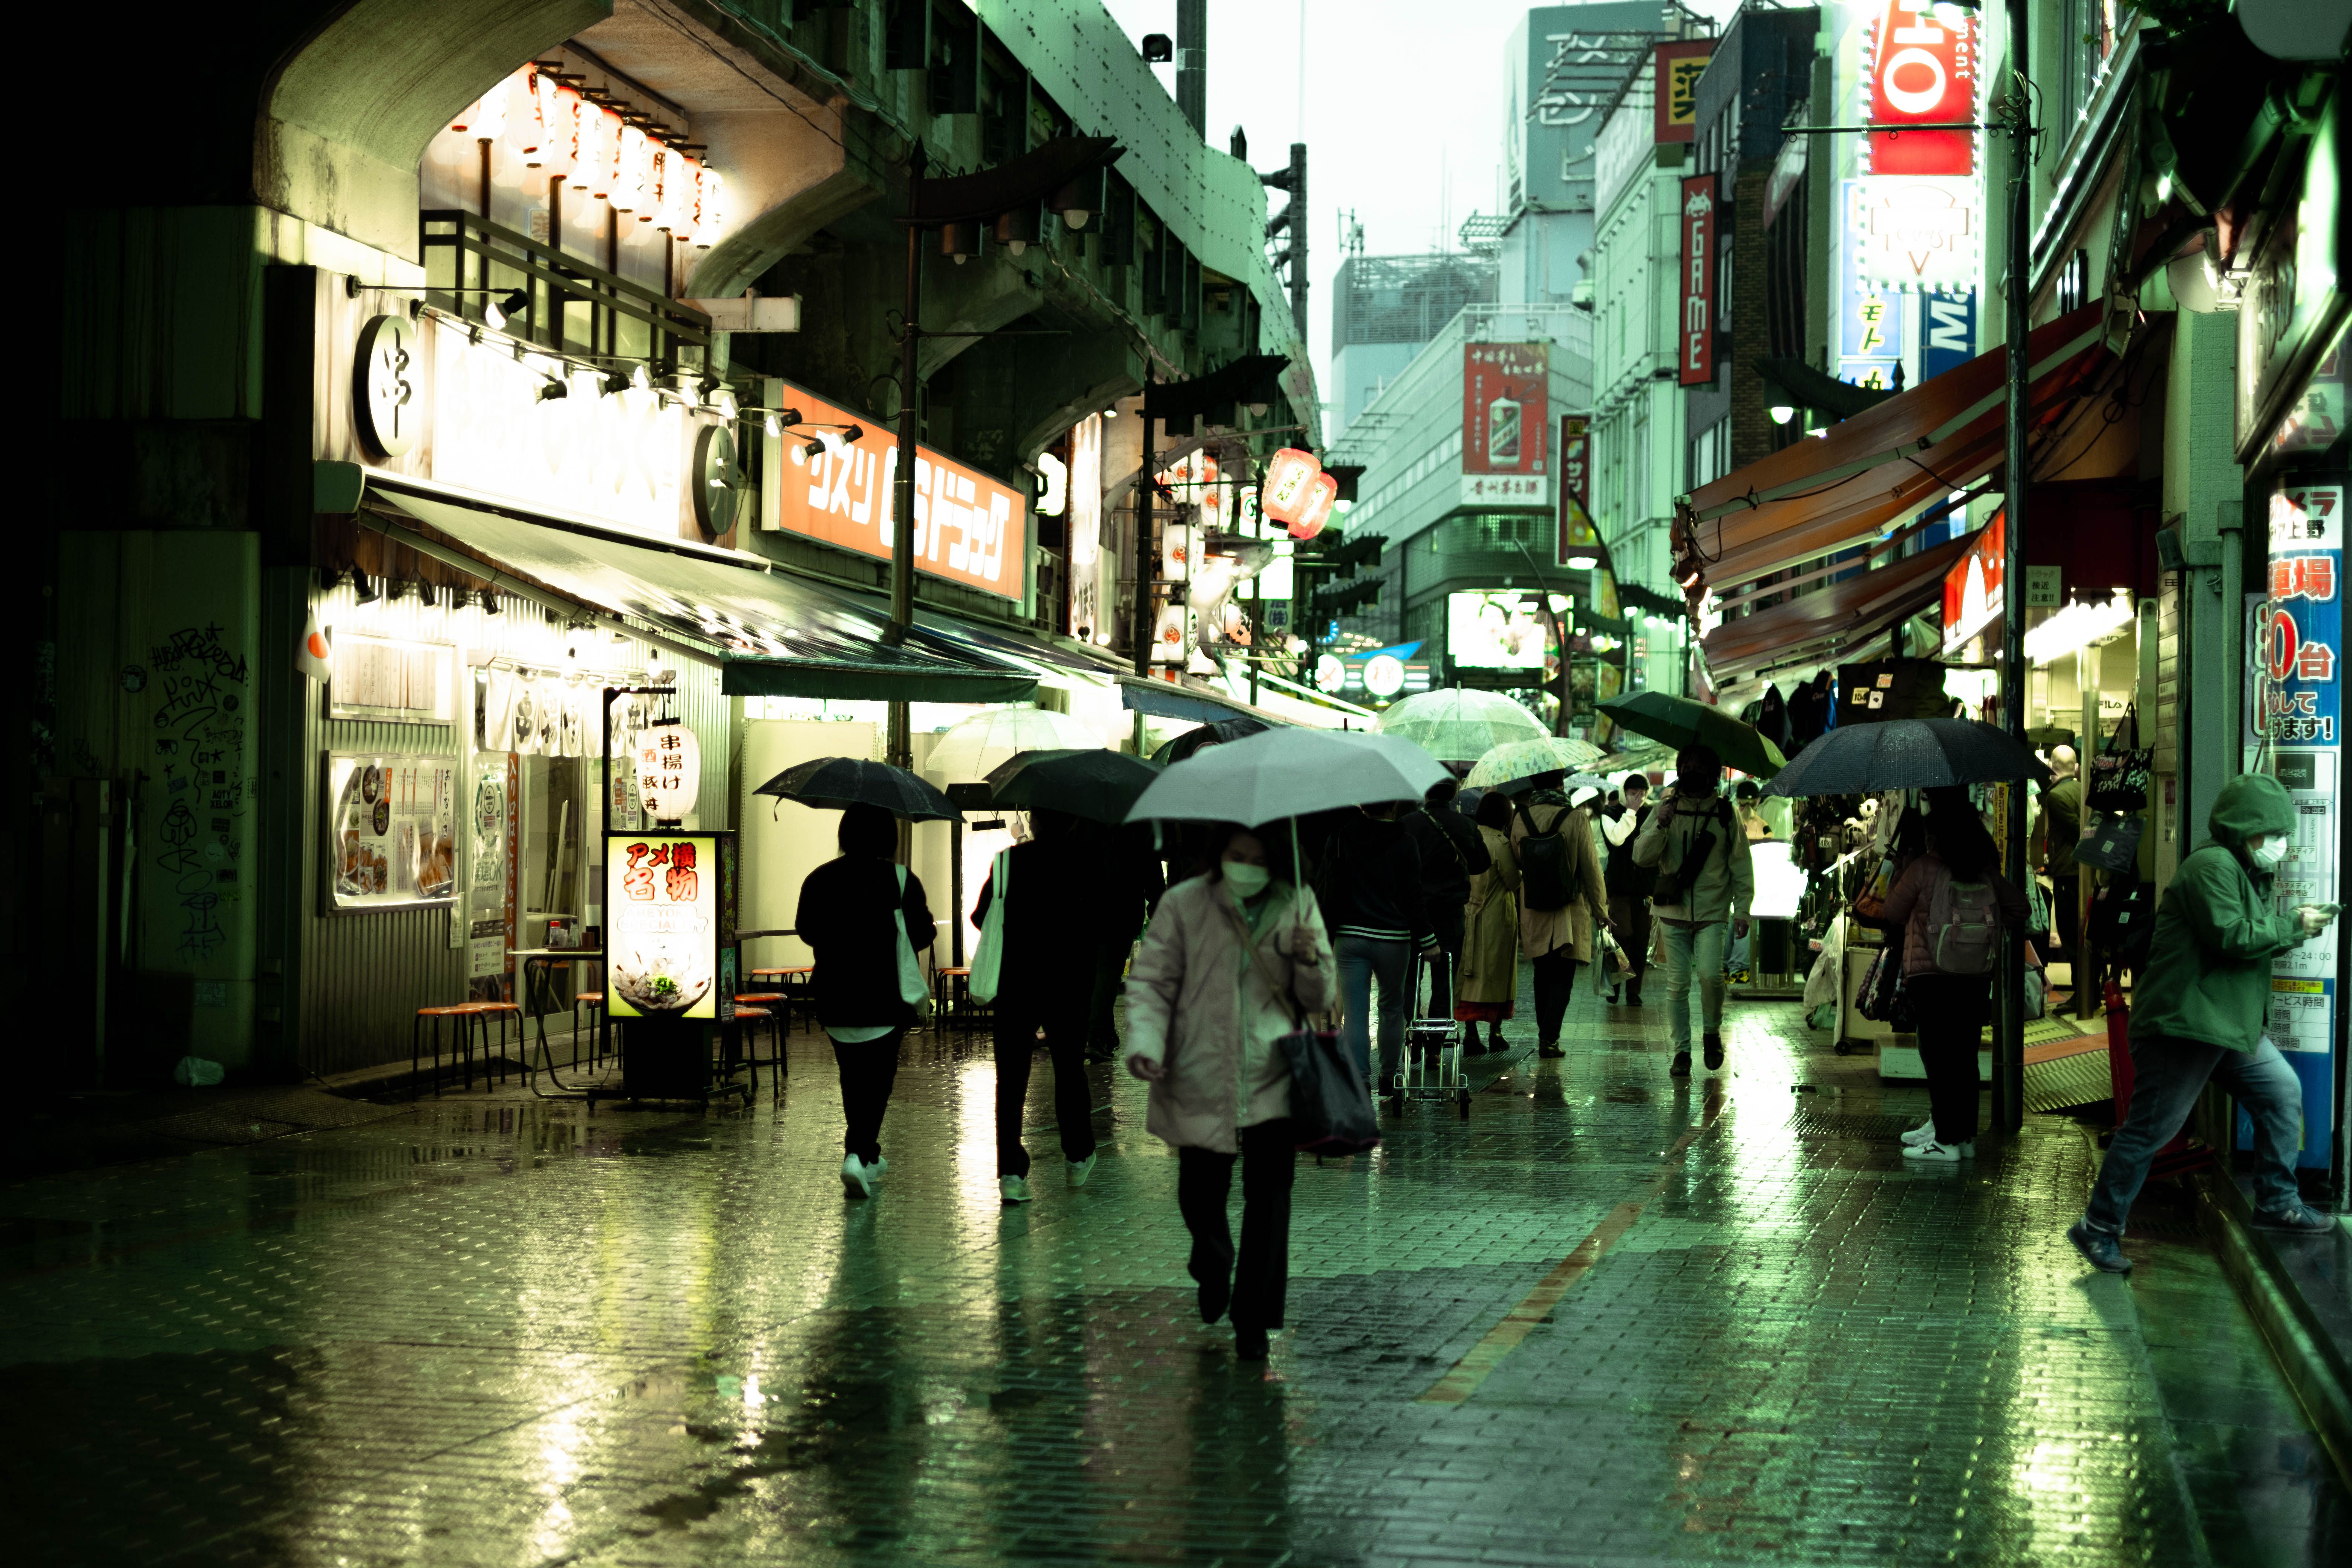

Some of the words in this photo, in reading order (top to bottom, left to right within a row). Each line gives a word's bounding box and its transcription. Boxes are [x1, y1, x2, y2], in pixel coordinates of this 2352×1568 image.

[1687, 221, 1706, 370] GAME
[2032, 581, 2049, 590] 接近
[660, 734, 682, 790] 串揚げ
[211, 800, 233, 809] XELOR
[626, 842, 697, 868] アメ横
[623, 867, 698, 902] 名物
